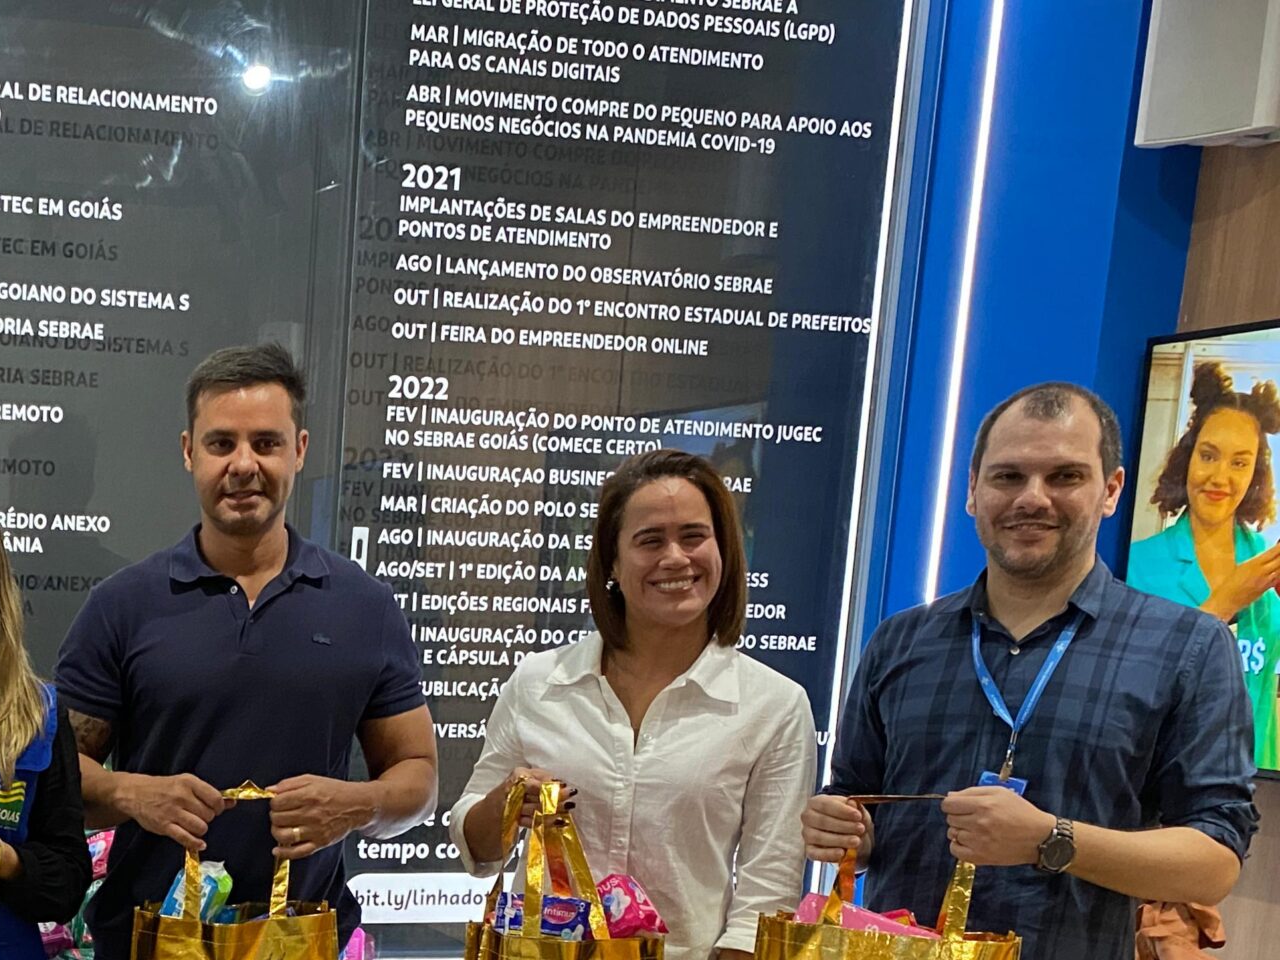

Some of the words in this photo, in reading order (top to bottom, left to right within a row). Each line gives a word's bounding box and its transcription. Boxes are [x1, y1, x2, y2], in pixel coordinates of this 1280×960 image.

[410, 23, 449, 44] MAR
[462, 28, 553, 55] MIGRAÇÃO
[556, 36, 578, 55] DE
[581, 38, 629, 59] TODO
[632, 43, 646, 61] O
[648, 45, 764, 71] ATENDIMENTO
[28, 82, 52, 102] DE
[56, 85, 218, 116] RELACIONAMENTO
[405, 108, 495, 133] PEQUENOS
[498, 113, 582, 139] NEGÓCIOS
[585, 123, 609, 142] NA
[613, 125, 697, 148] PANDEMIA
[700, 133, 776, 155] COVID-19
[401, 163, 461, 191] 2021
[38, 197, 64, 217] EM
[68, 196, 123, 221] GOIÁS
[398, 219, 466, 240] PONTOS
[470, 224, 492, 242] DE
[494, 226, 612, 250] ATENDIMENTO
[395, 254, 432, 272] AGO
[445, 256, 559, 281] LANÇAMENTO
[562, 264, 587, 282] DO
[590, 266, 711, 290] OBSERVATÓRIO
[713, 275, 773, 295] SEBRAE
[70, 286, 97, 305] DO
[100, 288, 176, 310] SISTEMA
[178, 293, 190, 311] S
[391, 322, 428, 340] OUT
[440, 324, 487, 344] FEIRA
[490, 327, 516, 345] DO
[518, 329, 648, 353] EMPREENDEDOR
[651, 337, 709, 356] ONLINE
[387, 374, 449, 401] 2022
[386, 405, 418, 423] FEV
[430, 407, 550, 435] INAUGURAÇÃO
[553, 413, 578, 430] DO
[580, 414, 636, 433] PONTO
[639, 417, 661, 434] DE
[663, 418, 774, 440] ATENDIMENTO
[775, 425, 823, 444] JUGEC
[380, 495, 418, 513] MAR
[430, 493, 503, 519] CRIAÇÃO
[505, 499, 530, 516] DO
[533, 500, 577, 518] POLO
[50, 514, 111, 533] ANEXO
[375, 559, 446, 580] AGO/SET
[476, 560, 536, 585] EDIÇÃO
[759, 634, 817, 651] SEBRAE
[357, 838, 430, 864] tempo
